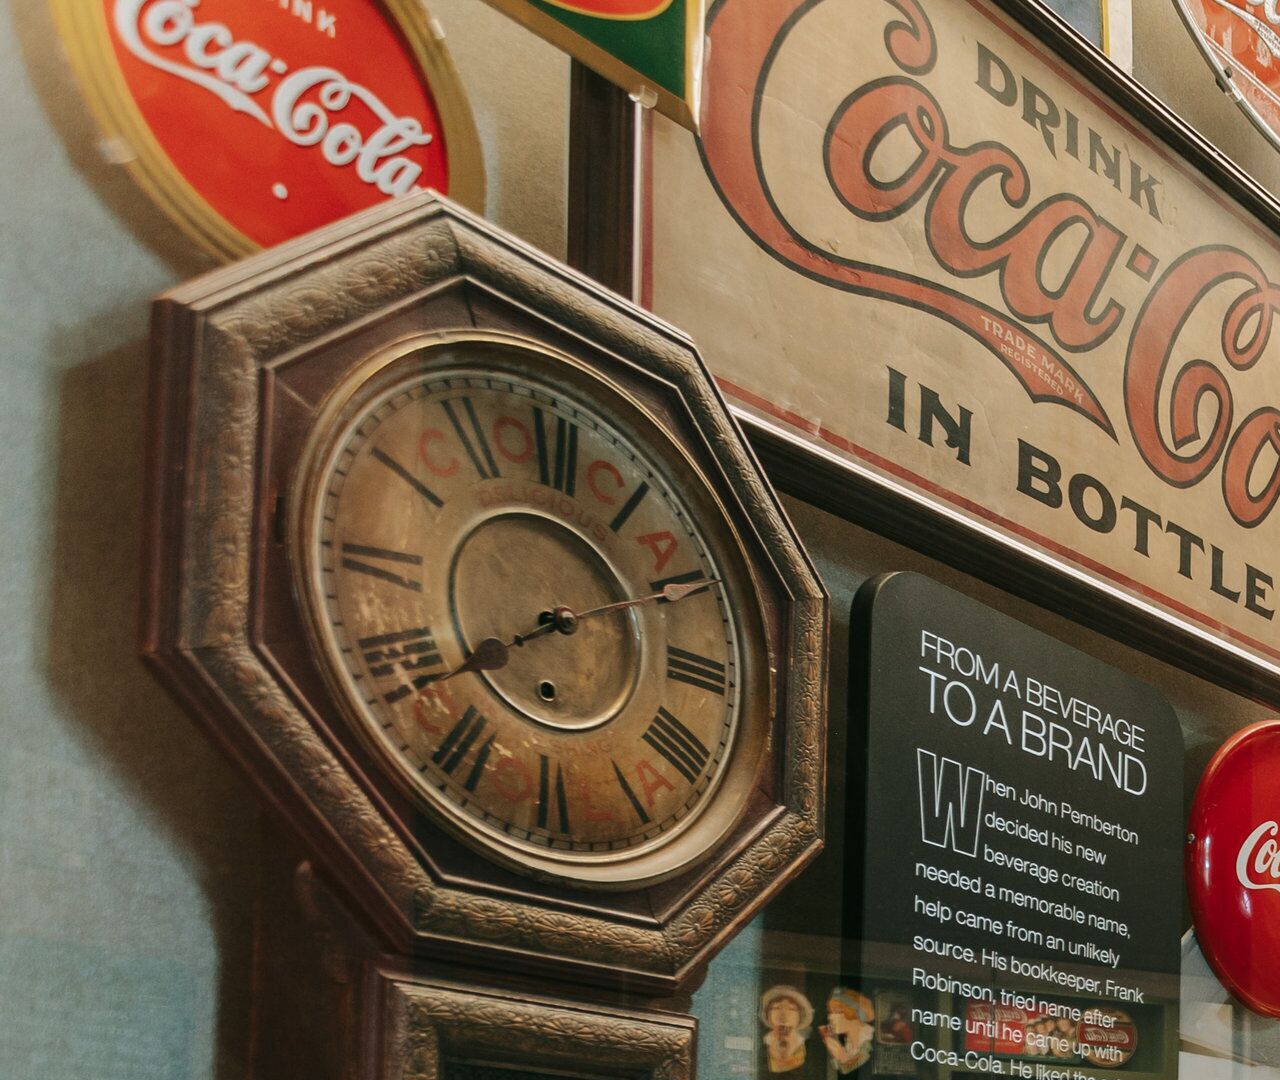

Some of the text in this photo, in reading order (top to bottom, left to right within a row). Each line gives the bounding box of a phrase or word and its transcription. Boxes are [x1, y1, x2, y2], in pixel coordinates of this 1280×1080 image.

[975, 41, 1164, 224] DRINK
[980, 314, 1085, 404] TRADE MARK
[999, 343, 1064, 396] REGISTERED
[886, 365, 975, 468] IN
[921, 629, 1145, 757] FROM A BEVERAGE
[918, 666, 1147, 796] TO A BRAND
[916, 747, 1139, 859] When John Pemberton
[984, 811, 1107, 865] decided his new
[915, 862, 1131, 939] needed a memorable name,
[984, 843, 1120, 902] beverage creation
[914, 894, 1120, 969] help came from an unlikely
[912, 967, 1118, 1032] Robinson, tried name after
[913, 935, 1145, 1004] source. His bookkeeper, Frank
[910, 1040, 1006, 1075] Coca-Cola.
[1010, 1059, 1033, 1079] He
[911, 1008, 1123, 1063] name until he came up with
